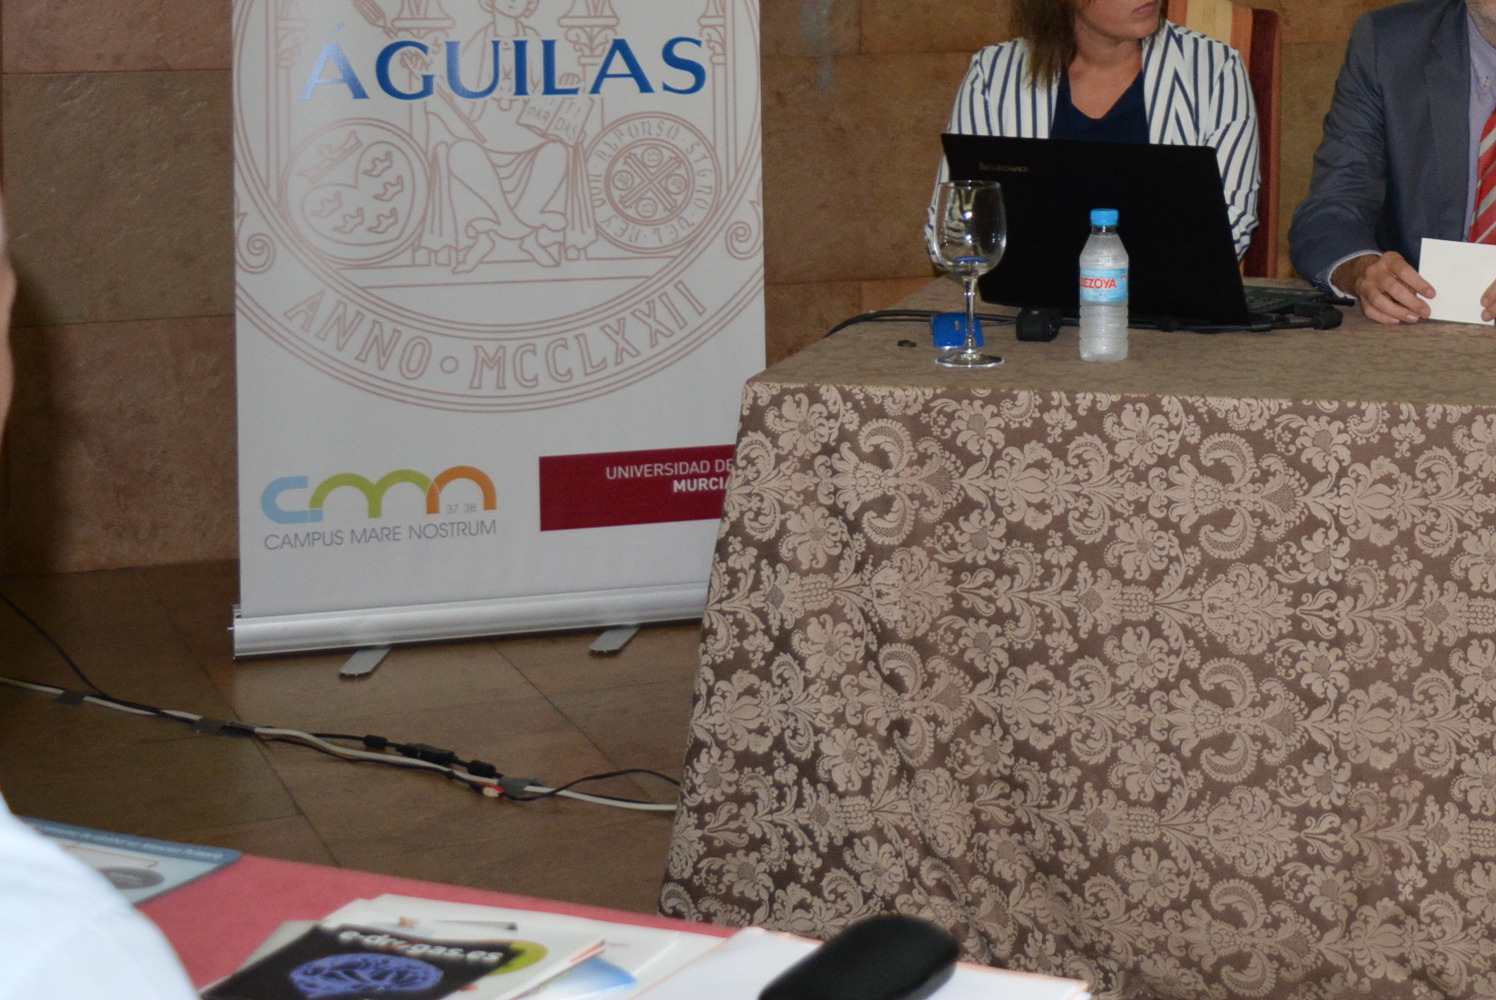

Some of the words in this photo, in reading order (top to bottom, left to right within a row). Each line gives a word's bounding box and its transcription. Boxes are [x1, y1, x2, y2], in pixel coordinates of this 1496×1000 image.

[283, 290, 432, 380] ANNO
[470, 281, 706, 390] MCCLXXII
[606, 460, 710, 480] UNIVERSIDAD
[264, 530, 344, 550] CAMPUS
[350, 526, 402, 544] MARE
[409, 519, 497, 540] NOSTRUM
